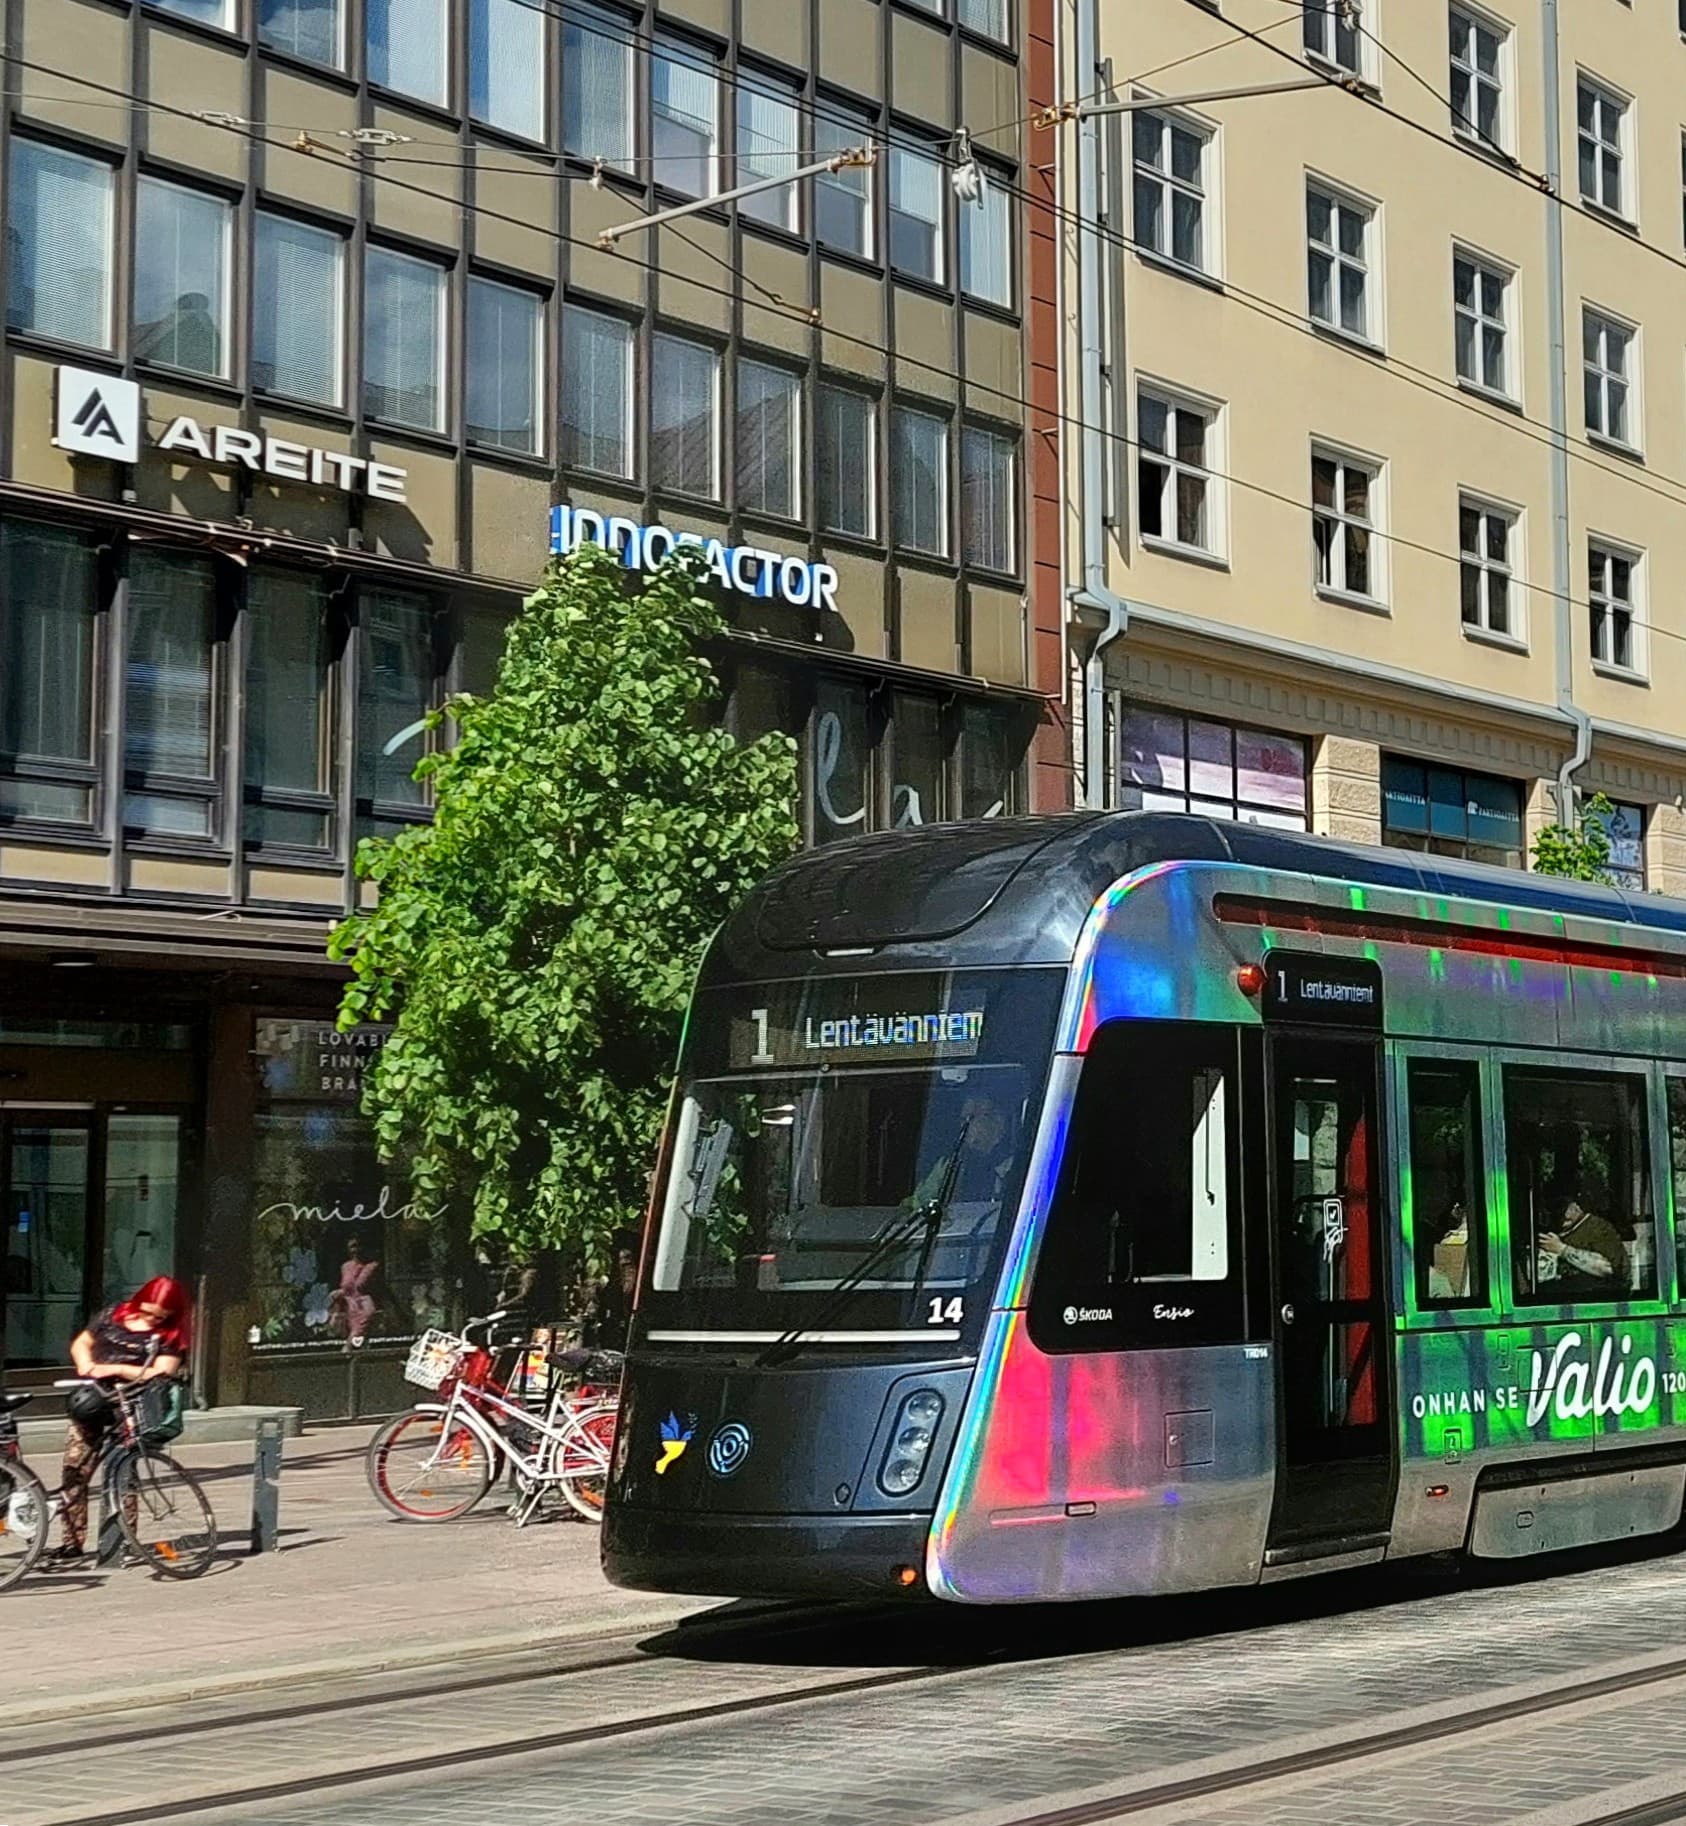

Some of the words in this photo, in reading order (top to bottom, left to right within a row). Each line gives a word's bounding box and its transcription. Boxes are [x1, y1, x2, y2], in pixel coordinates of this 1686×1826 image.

[158, 415, 408, 503] AREITE
[1278, 970, 1288, 1003] 1
[751, 1009, 774, 1065] 1
[927, 1296, 964, 1323] 14
[1078, 1306, 1113, 1321] ŠKODA
[1412, 1389, 1485, 1418] ONHAN
[1496, 1386, 1518, 1409] SE
[1526, 1332, 1656, 1428] Valio
[1662, 1372, 1686, 1394] 120
